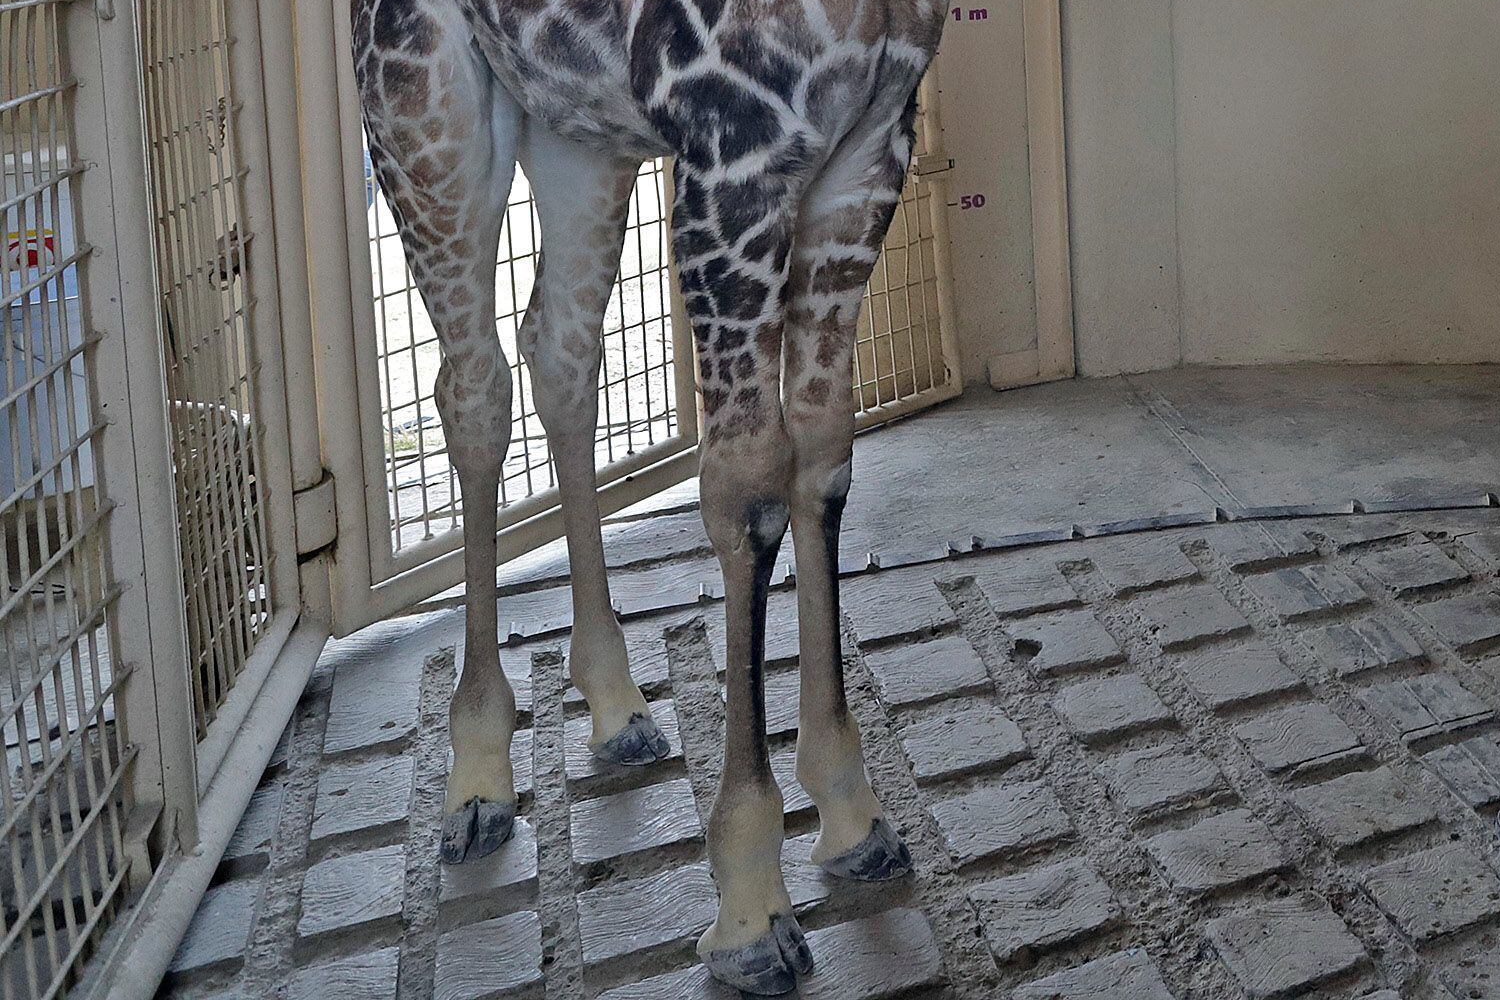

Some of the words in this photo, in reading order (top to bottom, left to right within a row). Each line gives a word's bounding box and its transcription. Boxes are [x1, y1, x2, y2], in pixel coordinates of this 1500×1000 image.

[951, 7, 962, 21] 1
[968, 7, 988, 20] m
[960, 194, 986, 210] 50
